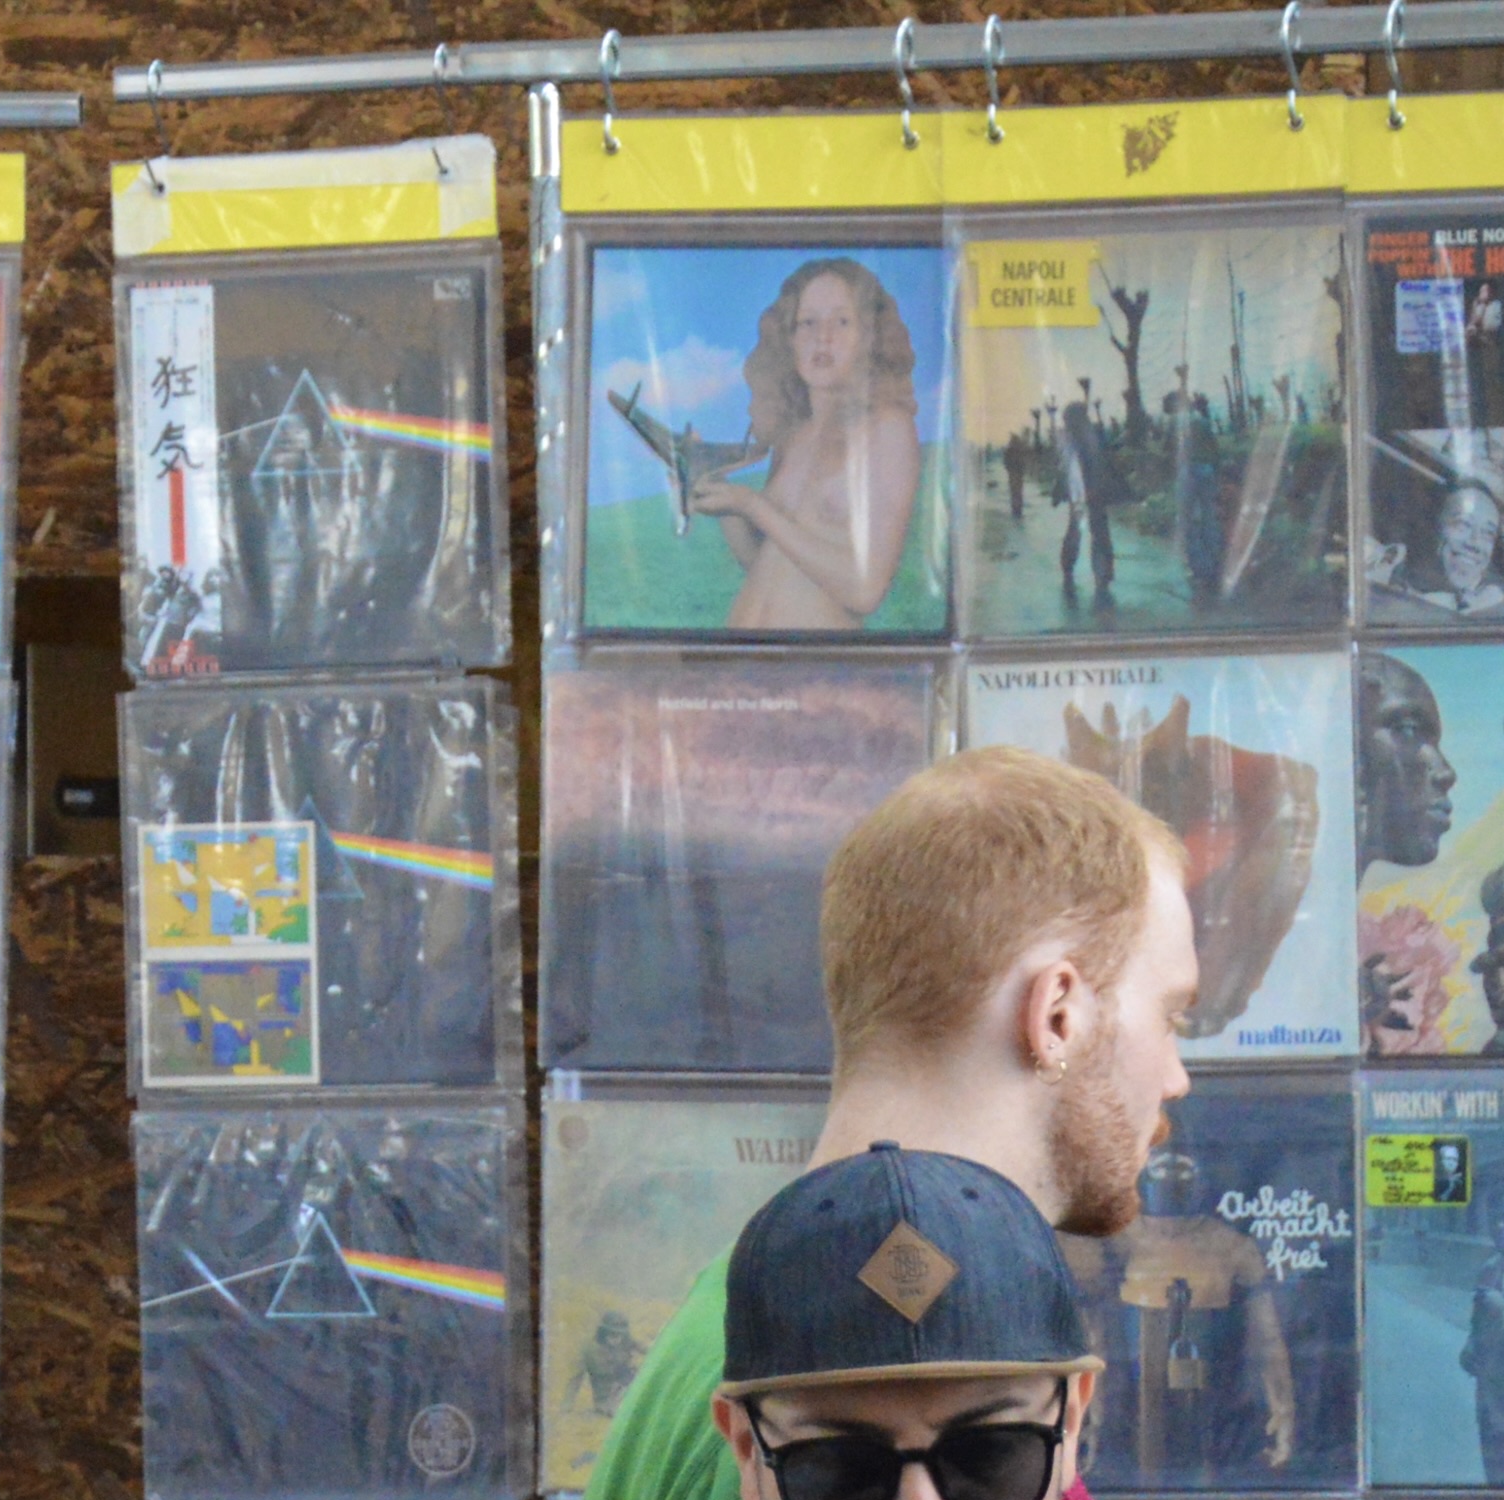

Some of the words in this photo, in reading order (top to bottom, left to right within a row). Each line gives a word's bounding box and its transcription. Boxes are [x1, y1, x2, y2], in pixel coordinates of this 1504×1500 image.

[1434, 228, 1478, 245] BLUE
[1001, 260, 1066, 283] NAPOLI
[989, 286, 1077, 310] CENTRALE
[977, 669, 1051, 692] NAPOLI
[1053, 665, 1165, 689] CENTRALE
[1237, 1024, 1344, 1047] mattanza
[1454, 1089, 1500, 1119] WITH
[1250, 1207, 1354, 1241] macht
[1265, 1237, 1330, 1283] frei
